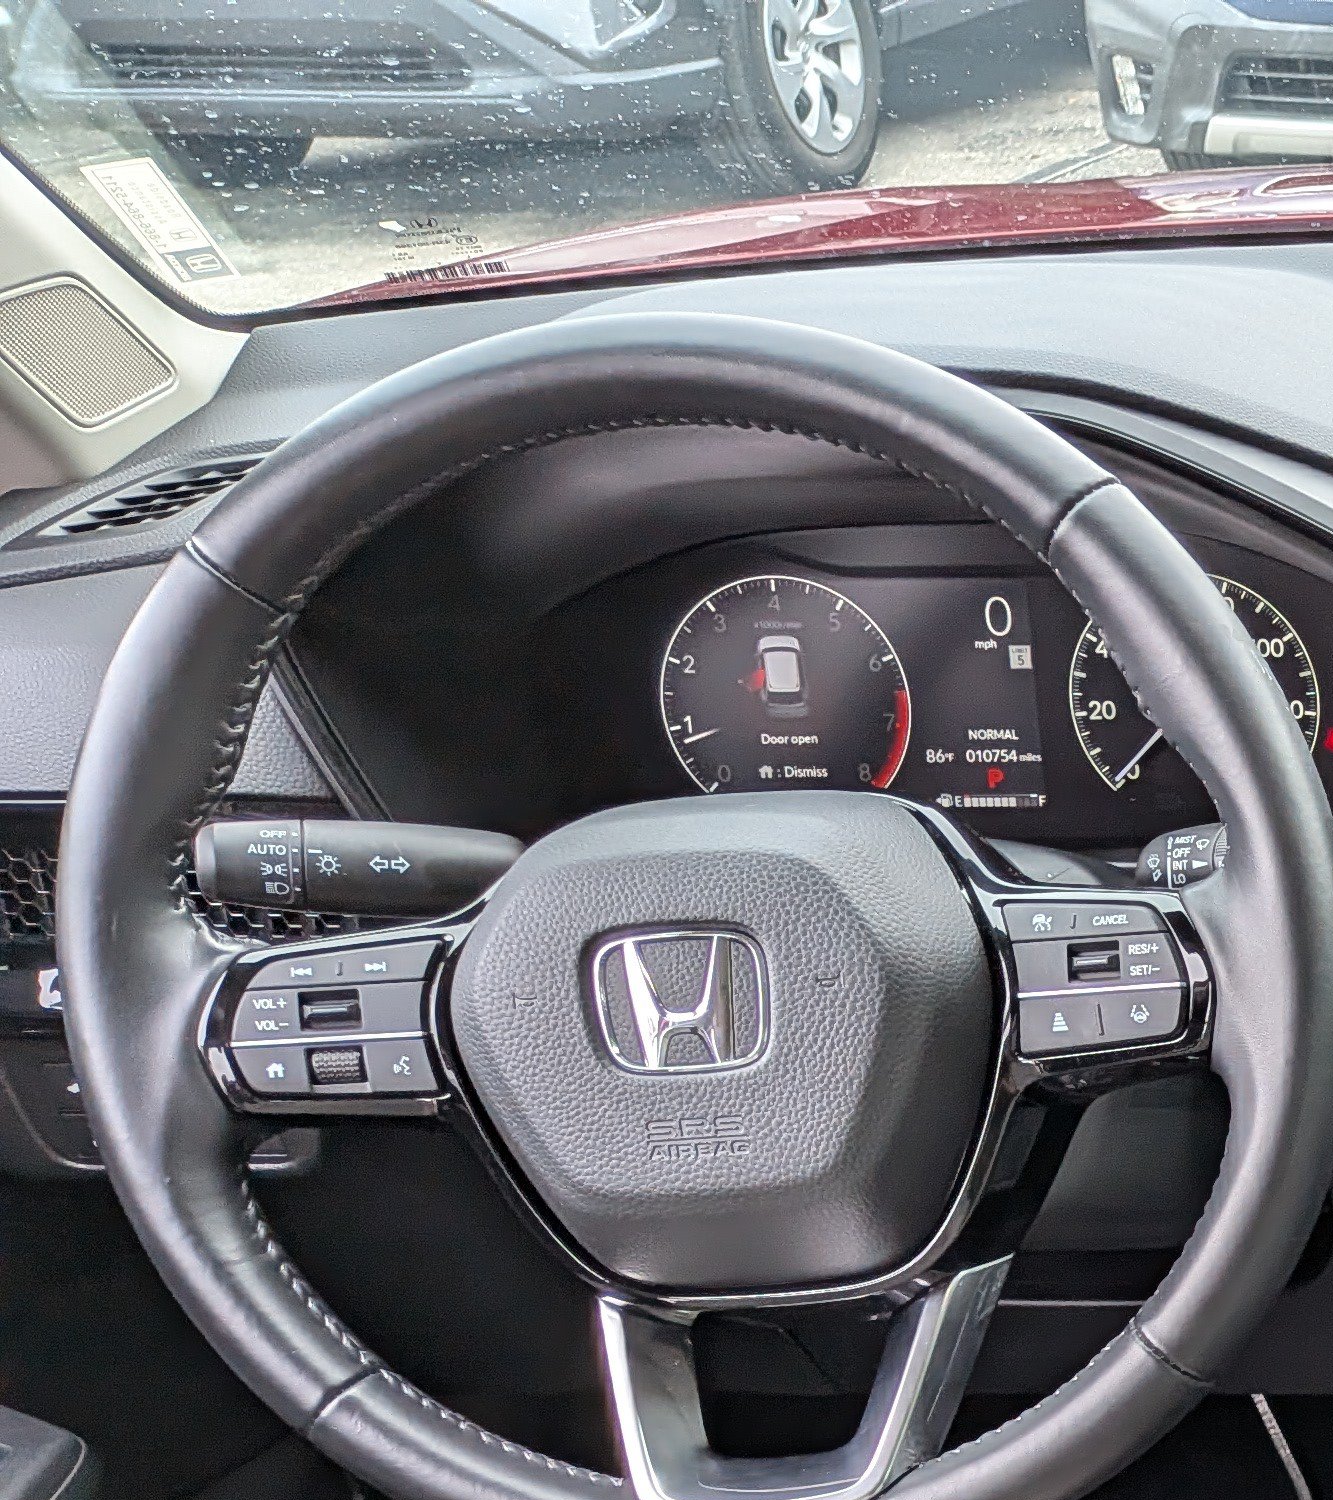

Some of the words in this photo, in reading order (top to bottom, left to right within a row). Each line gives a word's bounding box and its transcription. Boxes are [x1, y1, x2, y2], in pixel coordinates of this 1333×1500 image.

[767, 594, 782, 612] 4
[714, 613, 727, 633] 3
[828, 612, 841, 632] 5
[984, 596, 1012, 637] 0
[974, 639, 998, 651] mph
[1252, 638, 1285, 658] 00
[682, 655, 696, 674] 2
[869, 656, 882, 672] 6
[1017, 655, 1025, 667] 5
[1088, 701, 1117, 721] 20
[683, 715, 693, 734] 1
[761, 734, 789, 745] Door
[791, 735, 819, 748] open
[968, 729, 1019, 741] NORMAL
[966, 749, 1018, 763] 010754
[1019, 752, 1042, 763] miles
[718, 764, 731, 783] 0
[784, 765, 829, 779] Dismiss
[987, 767, 1005, 788] P
[954, 795, 962, 808] E
[1039, 795, 1047, 808] F
[259, 829, 287, 839] OFF
[247, 843, 287, 856] AUTO
[1172, 847, 1191, 858] OFF
[1172, 873, 1187, 885] LO
[1092, 914, 1129, 926] CANCEL
[1128, 942, 1159, 955] RES/+
[252, 998, 287, 1010] VOL+
[646, 1115, 746, 1140] SRS
[650, 1140, 751, 1161] AIRBAG
